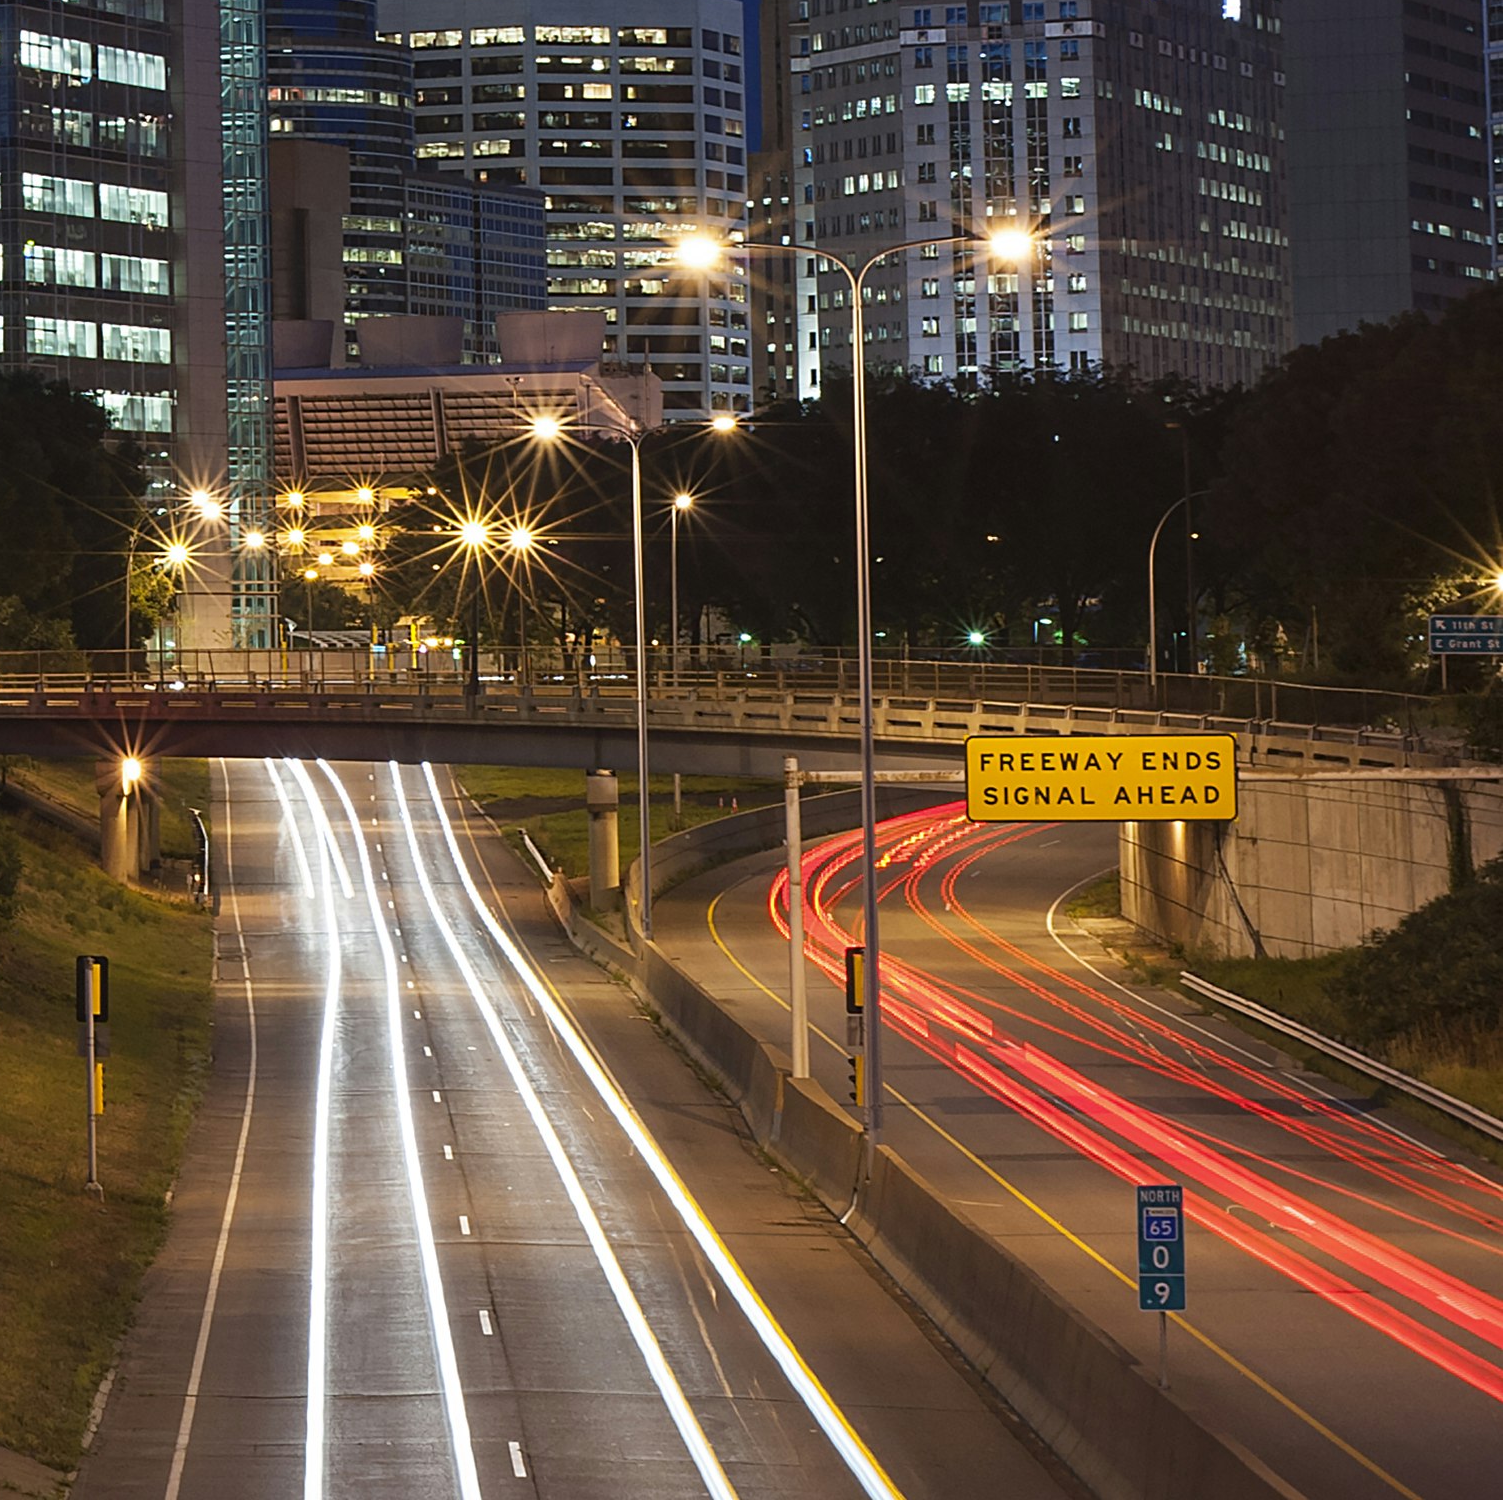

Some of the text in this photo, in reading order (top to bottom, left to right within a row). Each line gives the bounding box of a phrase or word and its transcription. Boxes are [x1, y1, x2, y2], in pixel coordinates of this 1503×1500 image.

[1452, 621, 1476, 630] 11th
[1435, 639, 1500, 649] E Grant St
[980, 752, 1222, 772] FREEWAY ENDS
[983, 785, 1220, 805] SIGNAL AHEAD
[1140, 1190, 1180, 1203] NORTH
[1150, 1220, 1172, 1235] 65
[1152, 1246, 1169, 1269] 0
